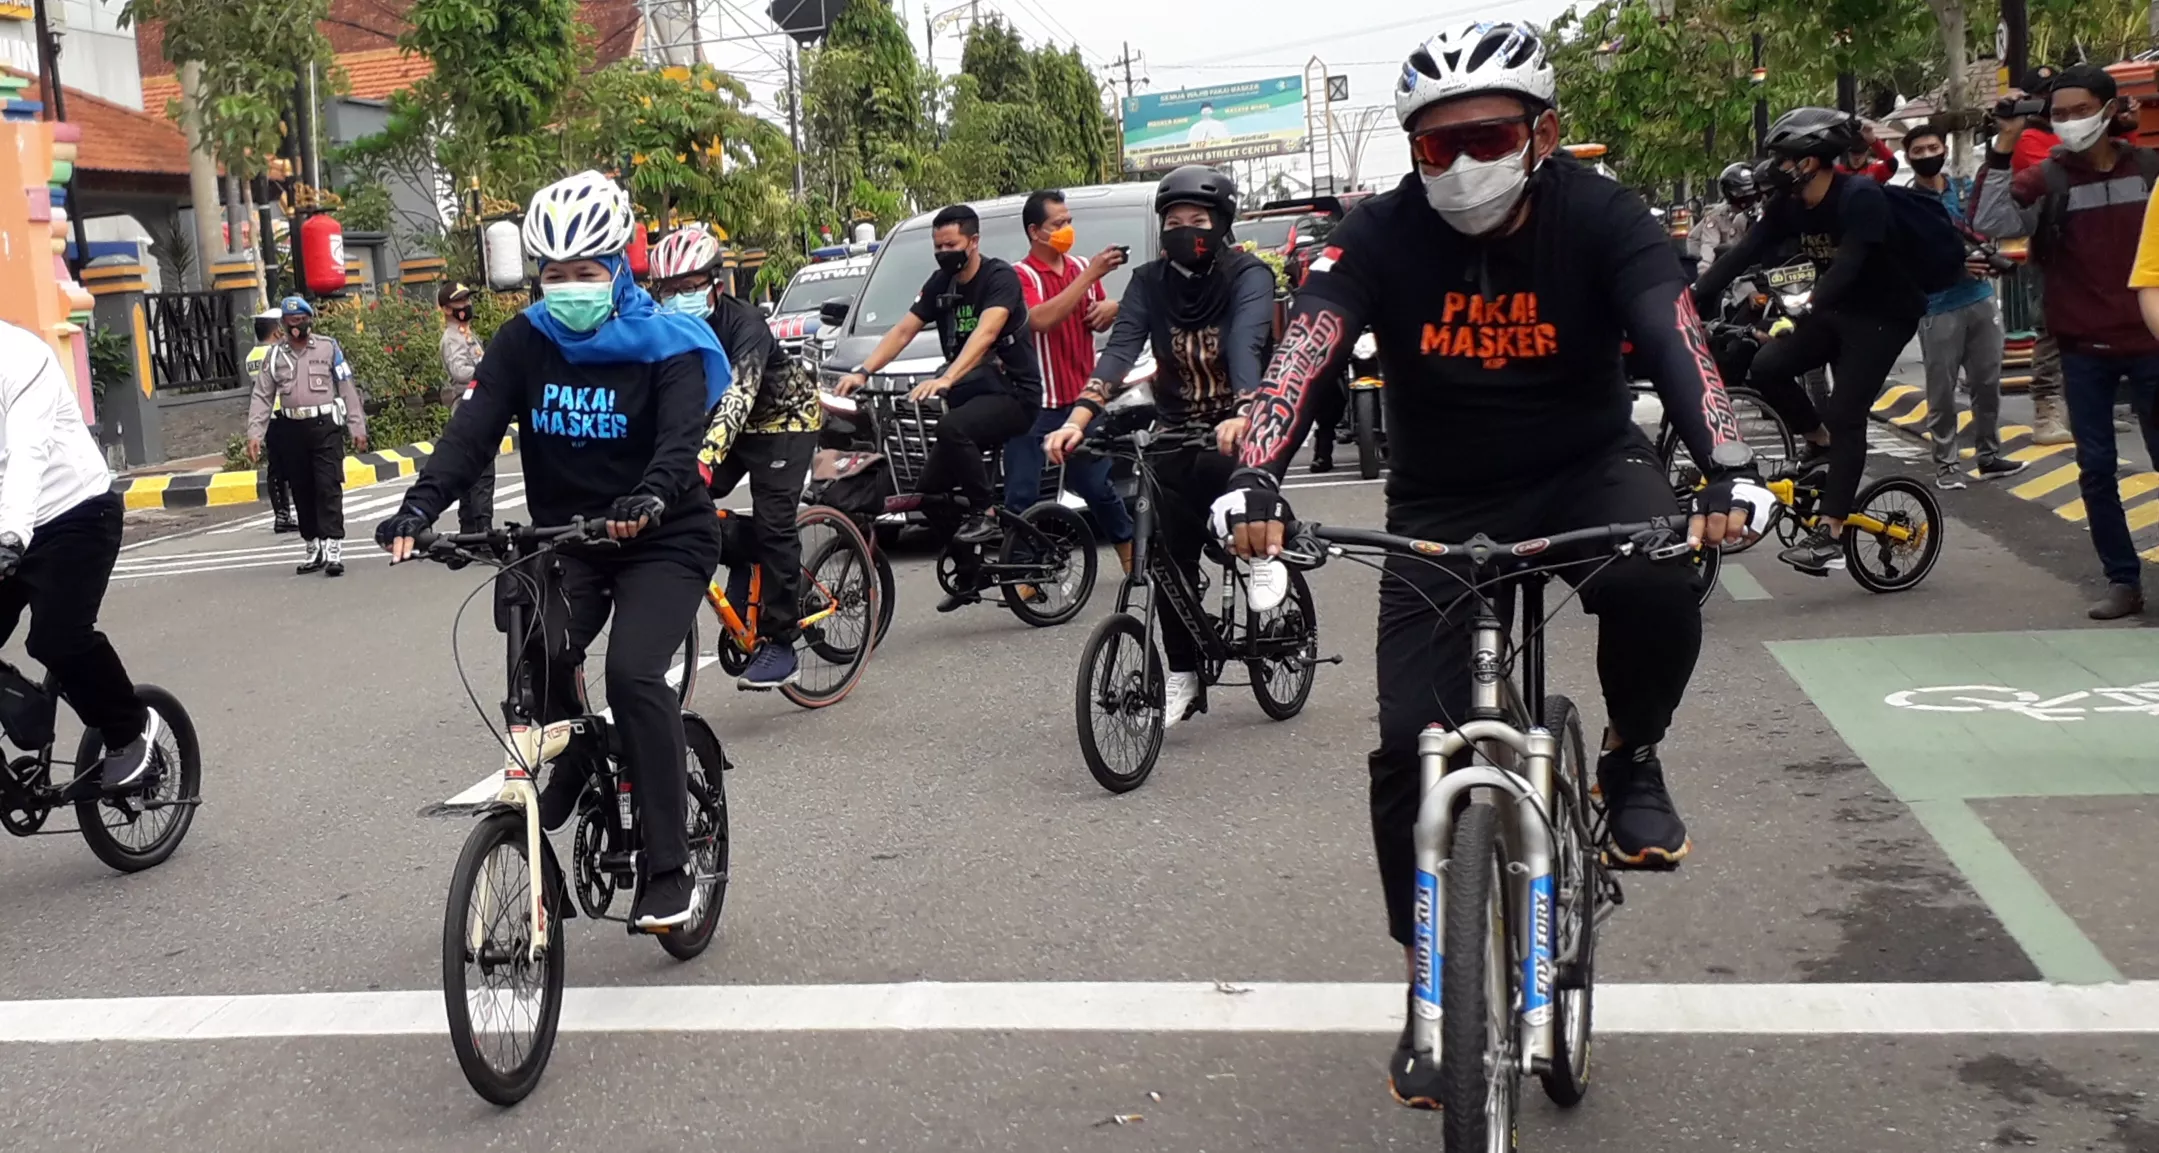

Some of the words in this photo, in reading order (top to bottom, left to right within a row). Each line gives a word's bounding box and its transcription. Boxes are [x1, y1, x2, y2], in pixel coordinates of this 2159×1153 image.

[1152, 152, 1202, 167] PAHLAWAN
[1206, 149, 1239, 161] STREET
[1241, 143, 1278, 156] CENTER
[1420, 322, 1558, 358] MASKER
[531, 408, 628, 439] MASKER
